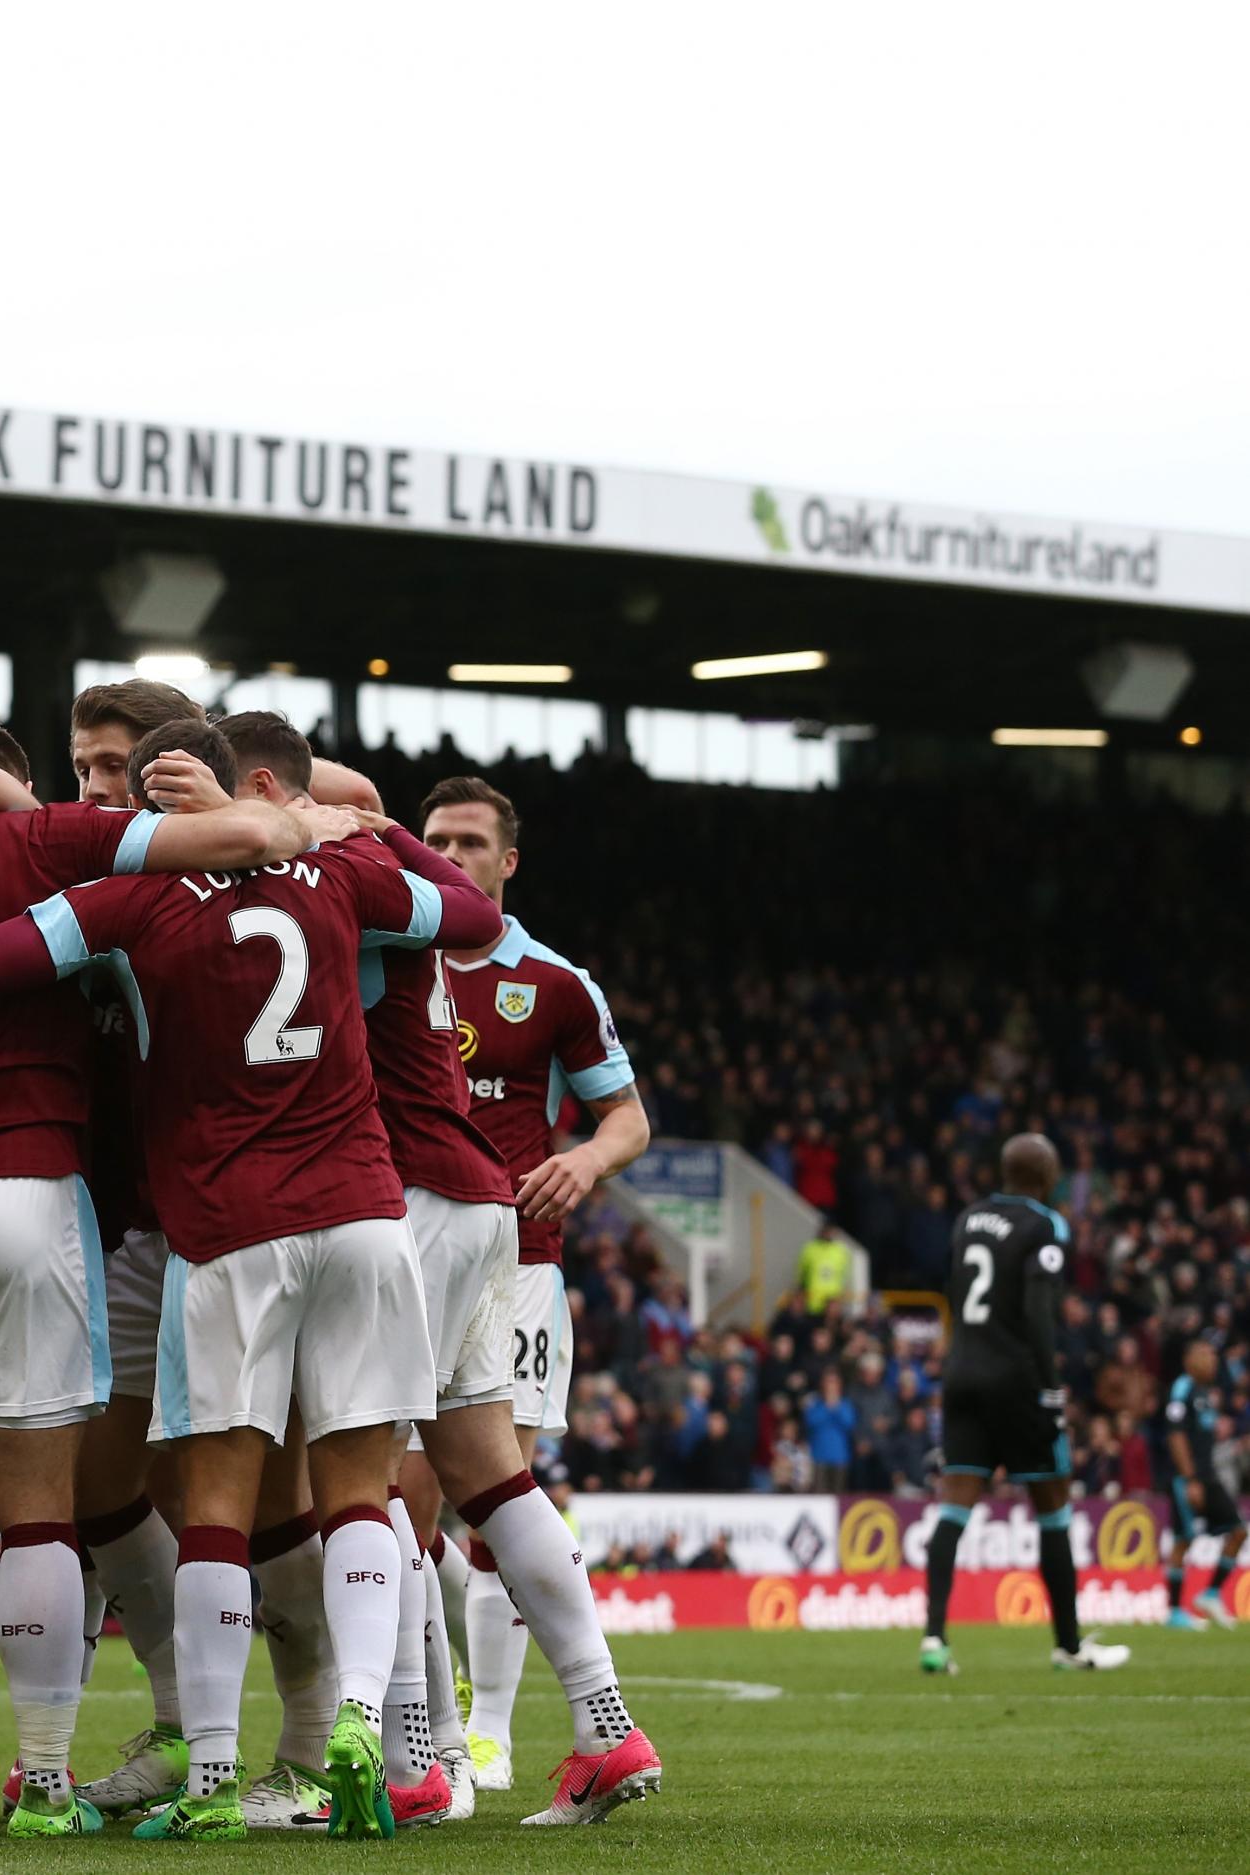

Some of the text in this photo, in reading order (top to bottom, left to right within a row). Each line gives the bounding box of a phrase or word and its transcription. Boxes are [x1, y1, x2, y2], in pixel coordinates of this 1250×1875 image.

[52, 416, 411, 519] FURNITURE
[447, 457, 598, 535] LAND
[800, 497, 1161, 588] Oakfurnitureland
[227, 906, 324, 1066] 2
[963, 1243, 994, 1324] 2
[513, 1328, 549, 1381] 28
[346, 1571, 386, 1585] BFC
[1, 1623, 44, 1637] BFC
[219, 1610, 251, 1629] BFC
